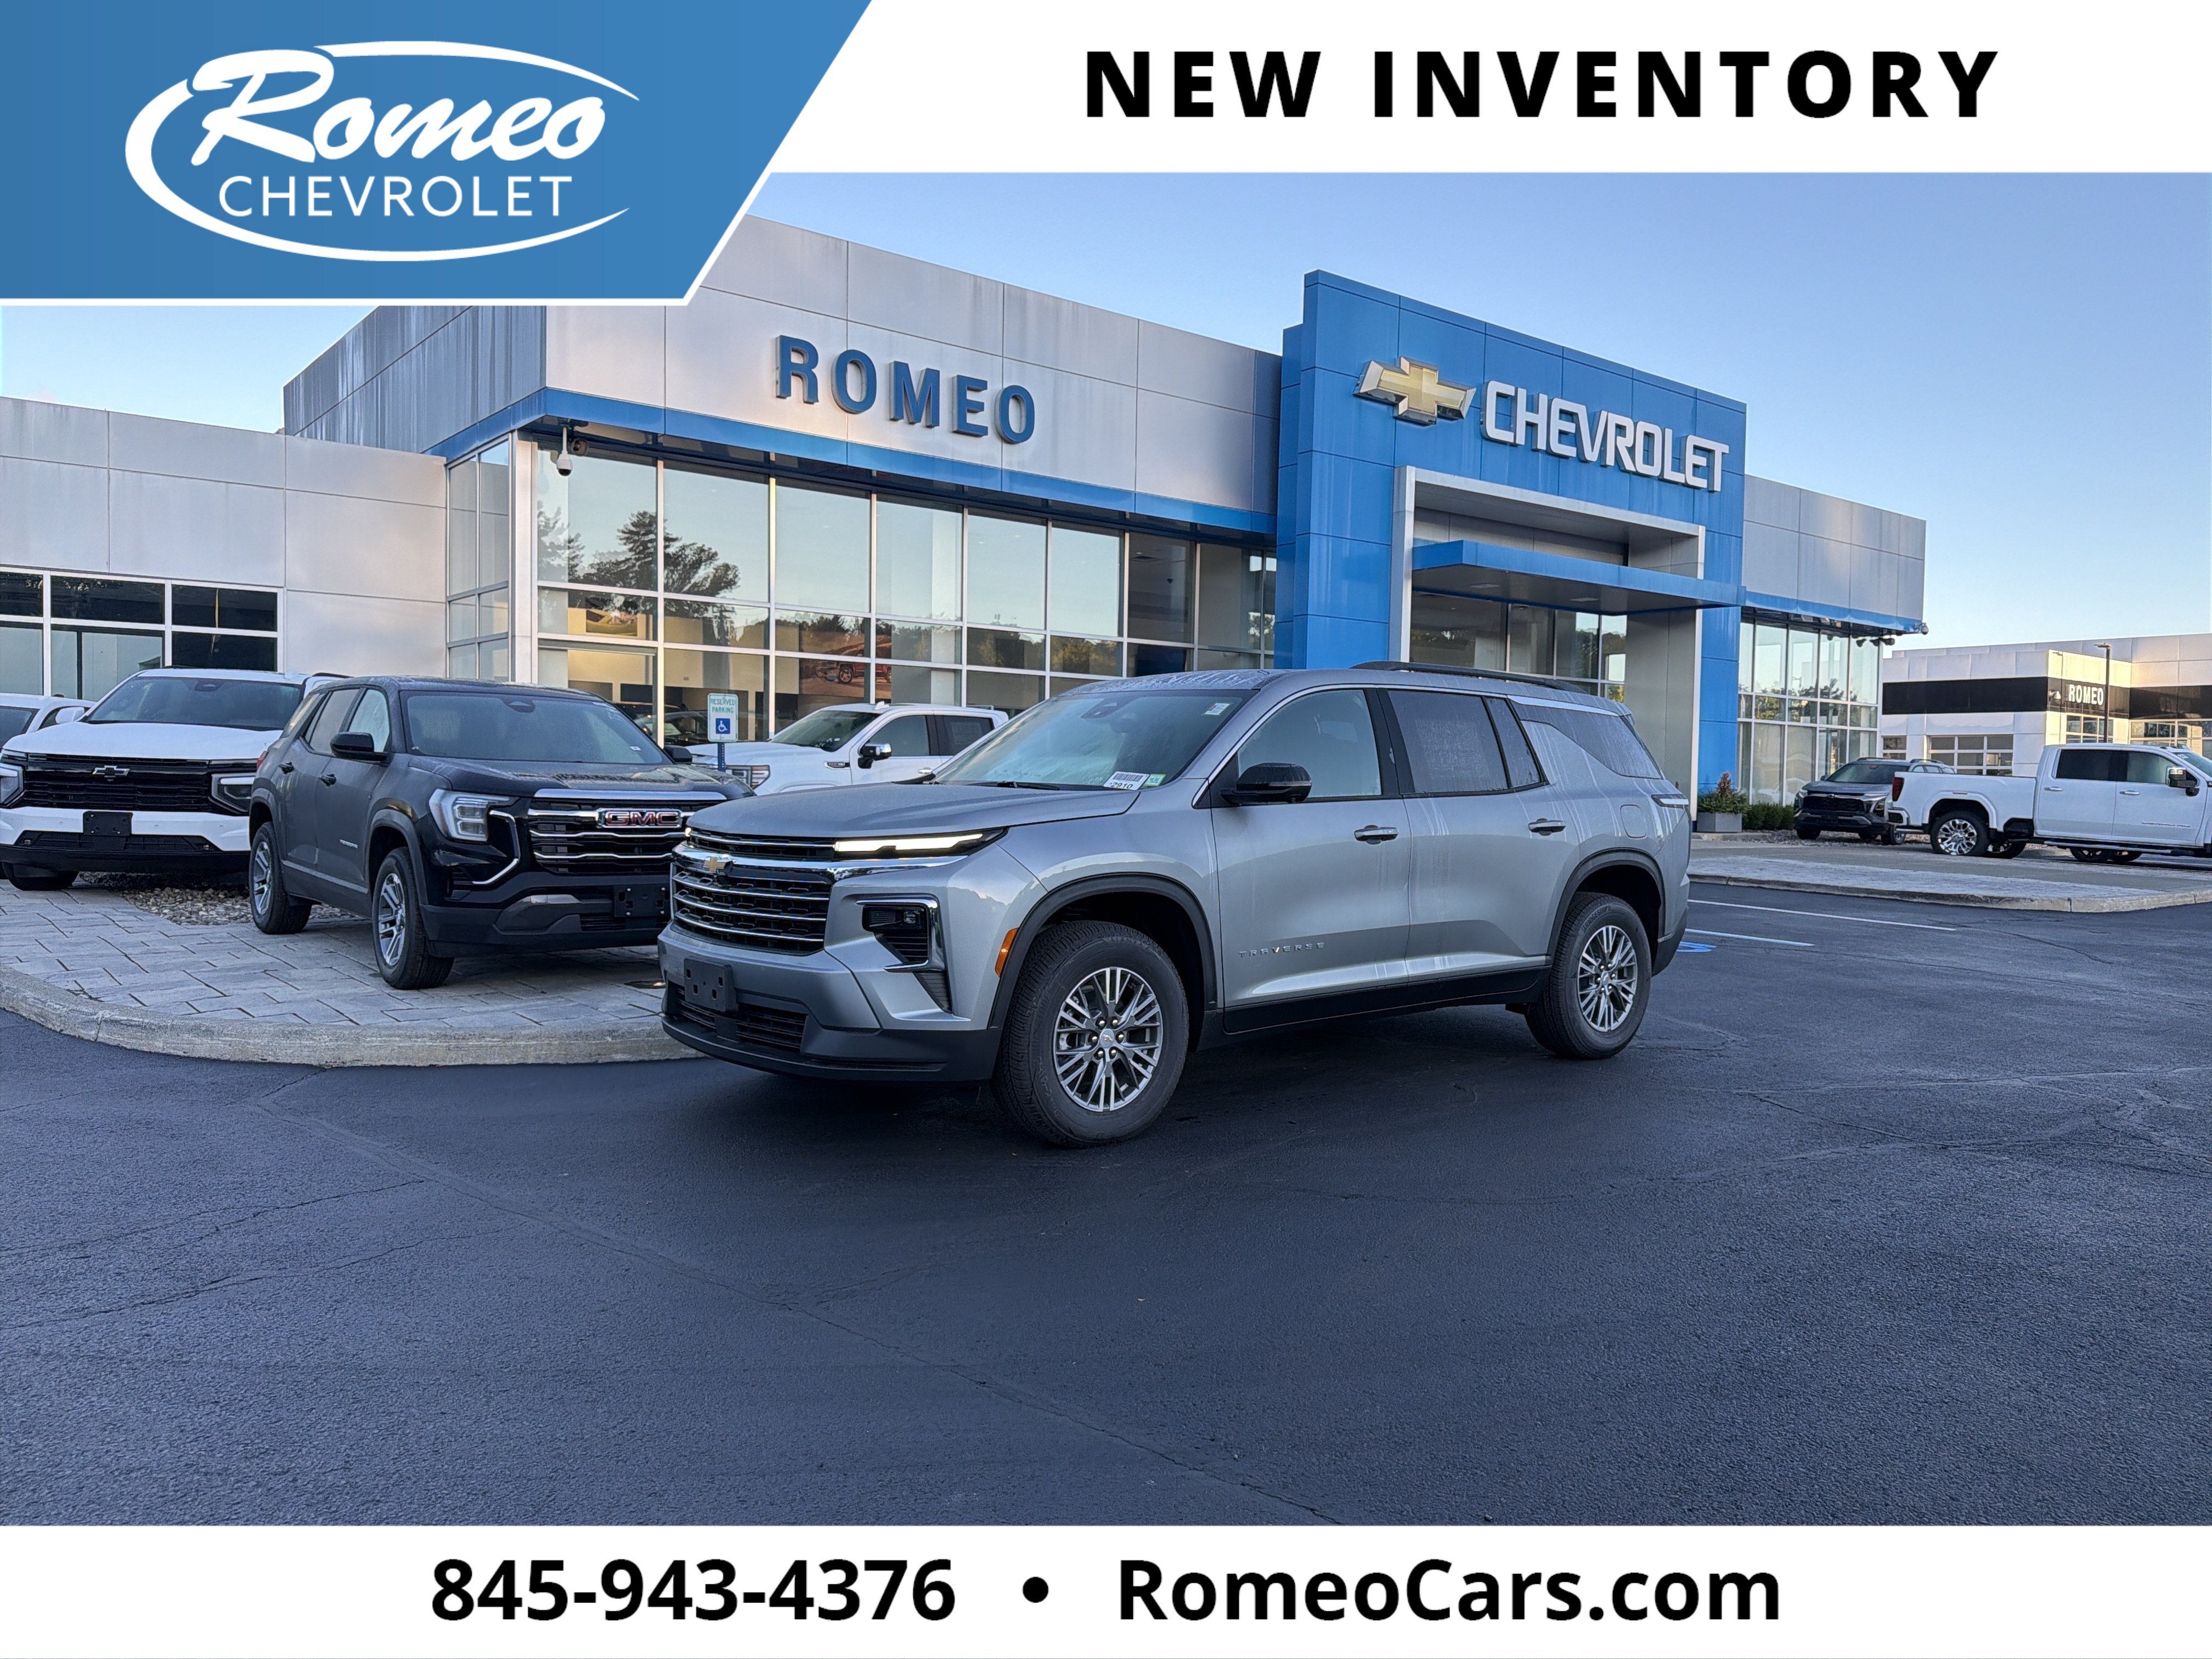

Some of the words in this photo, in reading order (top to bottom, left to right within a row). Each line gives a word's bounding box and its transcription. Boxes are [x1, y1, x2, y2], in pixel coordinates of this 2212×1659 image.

[776, 335, 1035, 444] ROMEO
[1483, 380, 1729, 493] CHEVROLET
[2069, 684, 2104, 705] ROMEO
[605, 811, 679, 826] GMC
[1238, 942, 1325, 958] TRAVERSE
